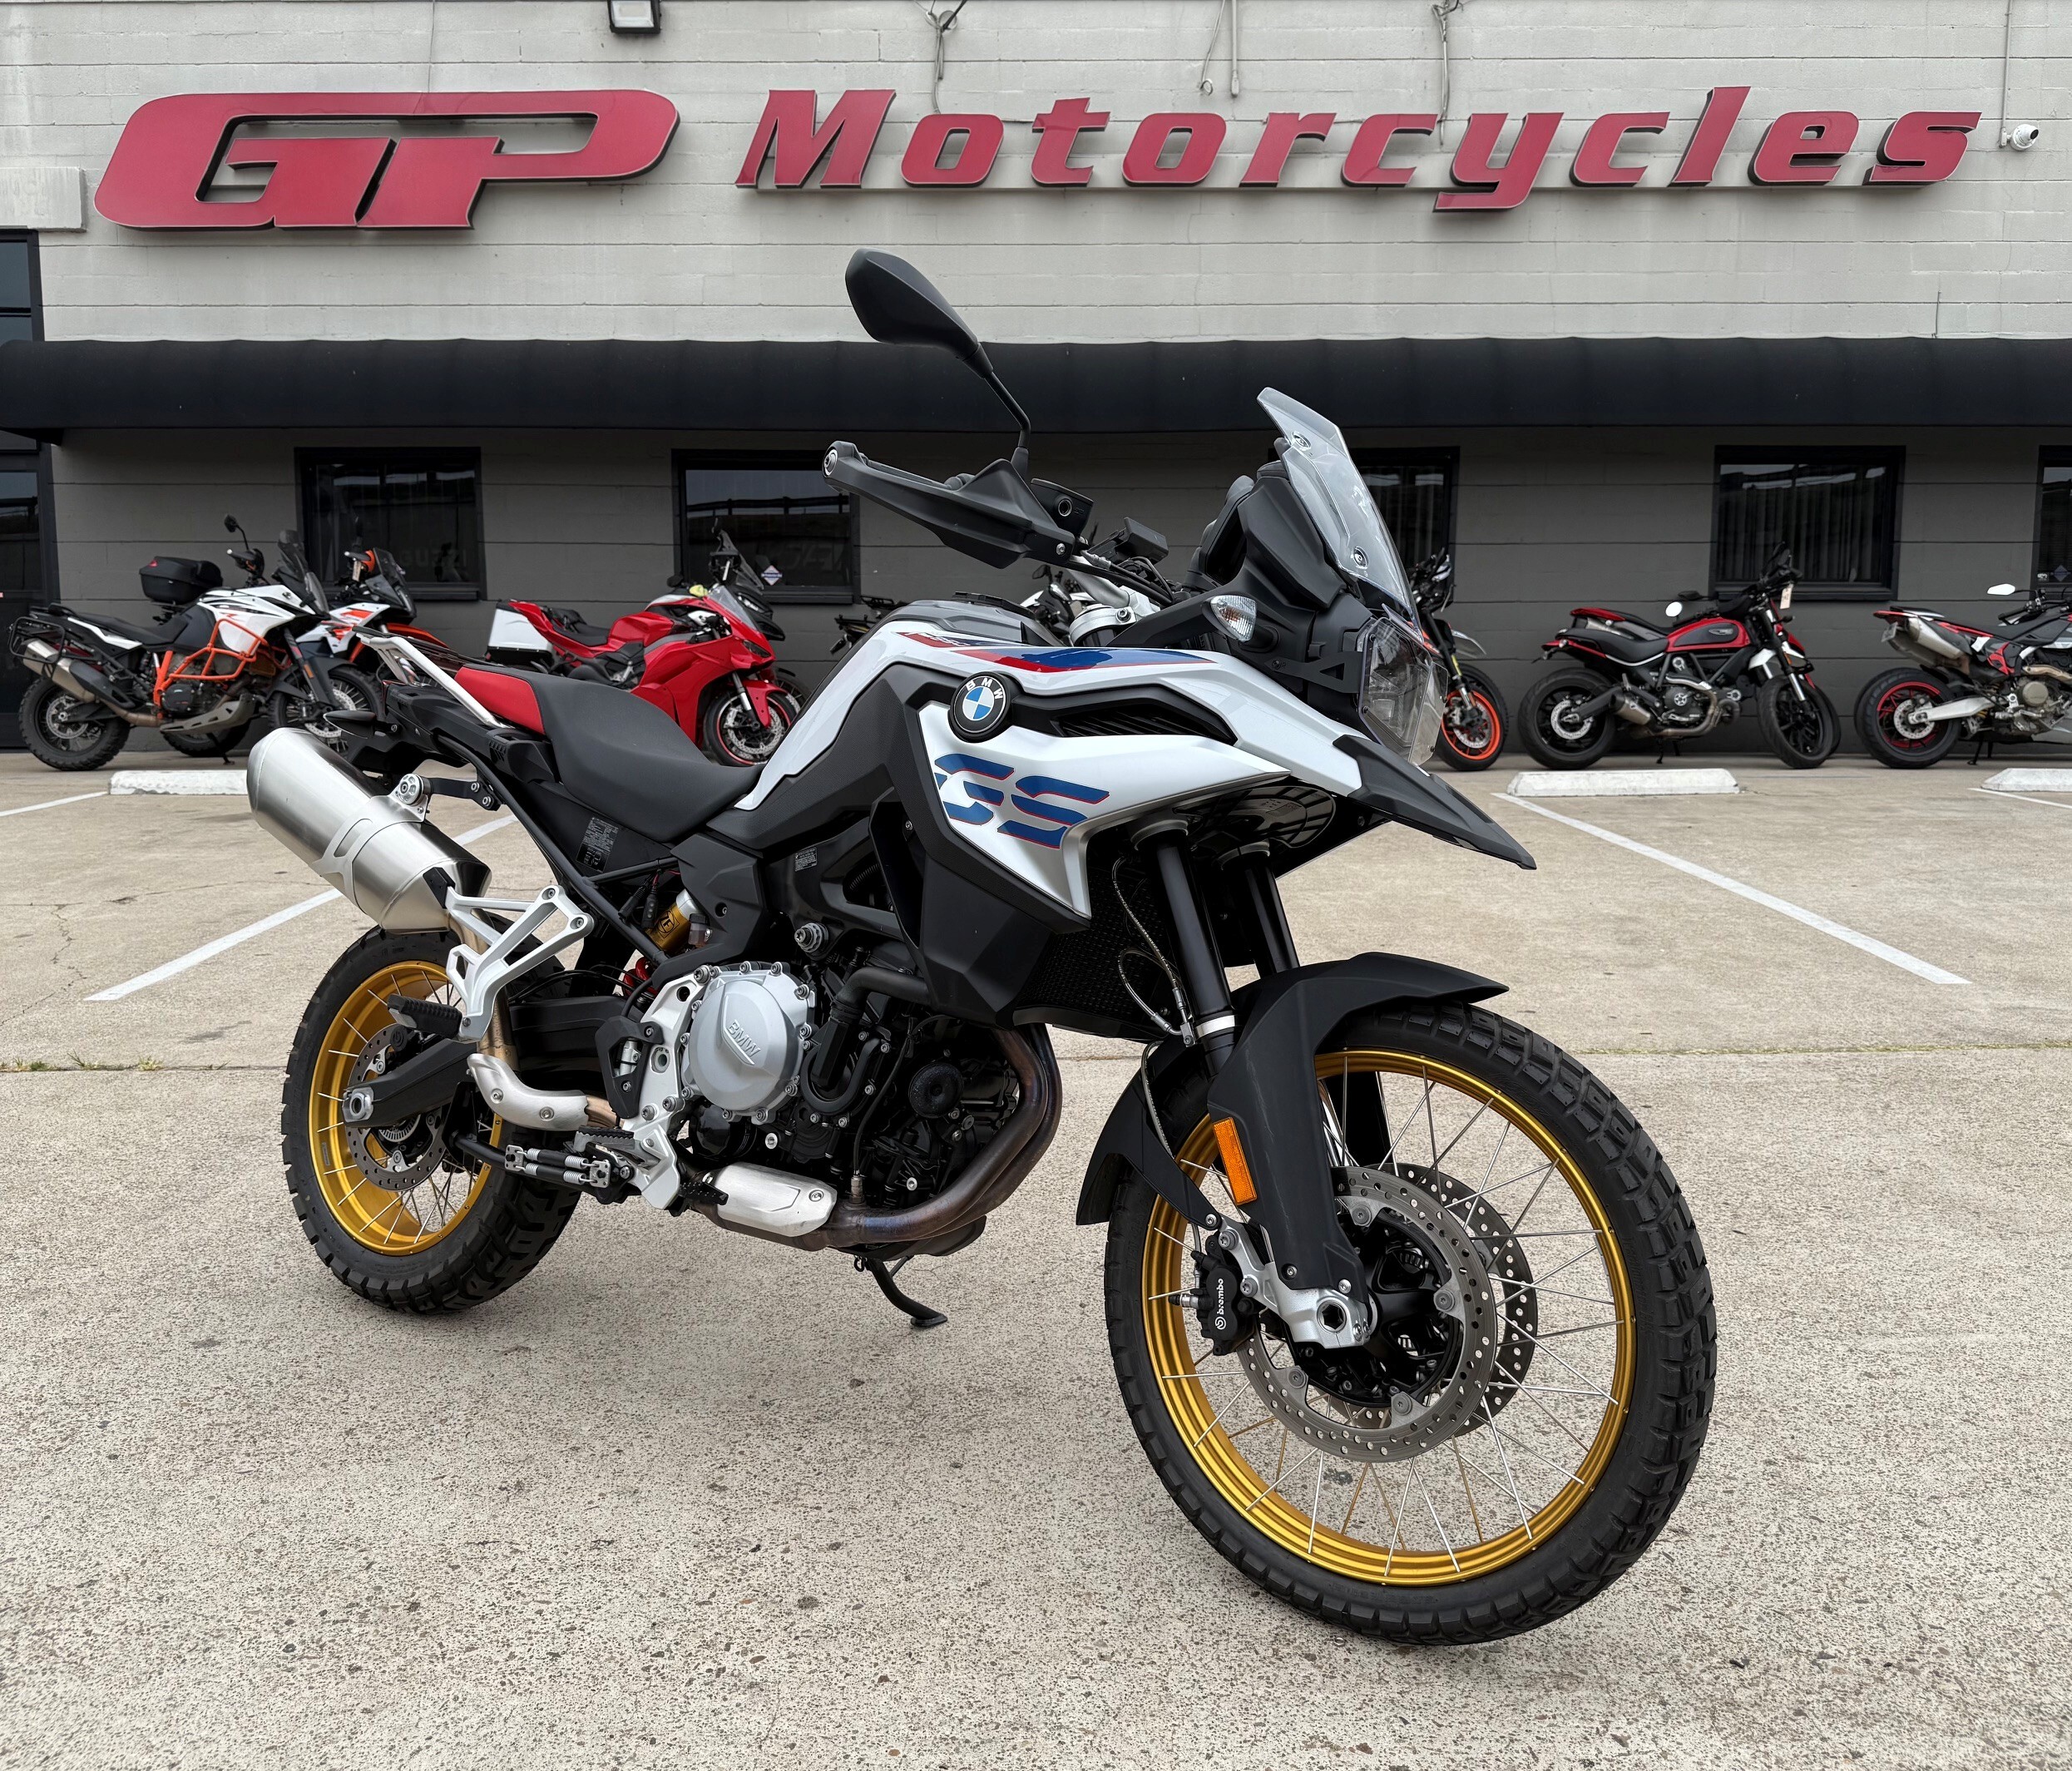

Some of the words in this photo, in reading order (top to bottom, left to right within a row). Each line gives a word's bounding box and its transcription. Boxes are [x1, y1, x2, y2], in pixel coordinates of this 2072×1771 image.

[94, 89, 680, 230] GP
[734, 87, 1981, 211] Motorcycles
[965, 676, 1004, 700] BMW
[934, 753, 1110, 849] GS
[727, 1019, 761, 1057] BMW
[1216, 1278, 1224, 1315] brembo
